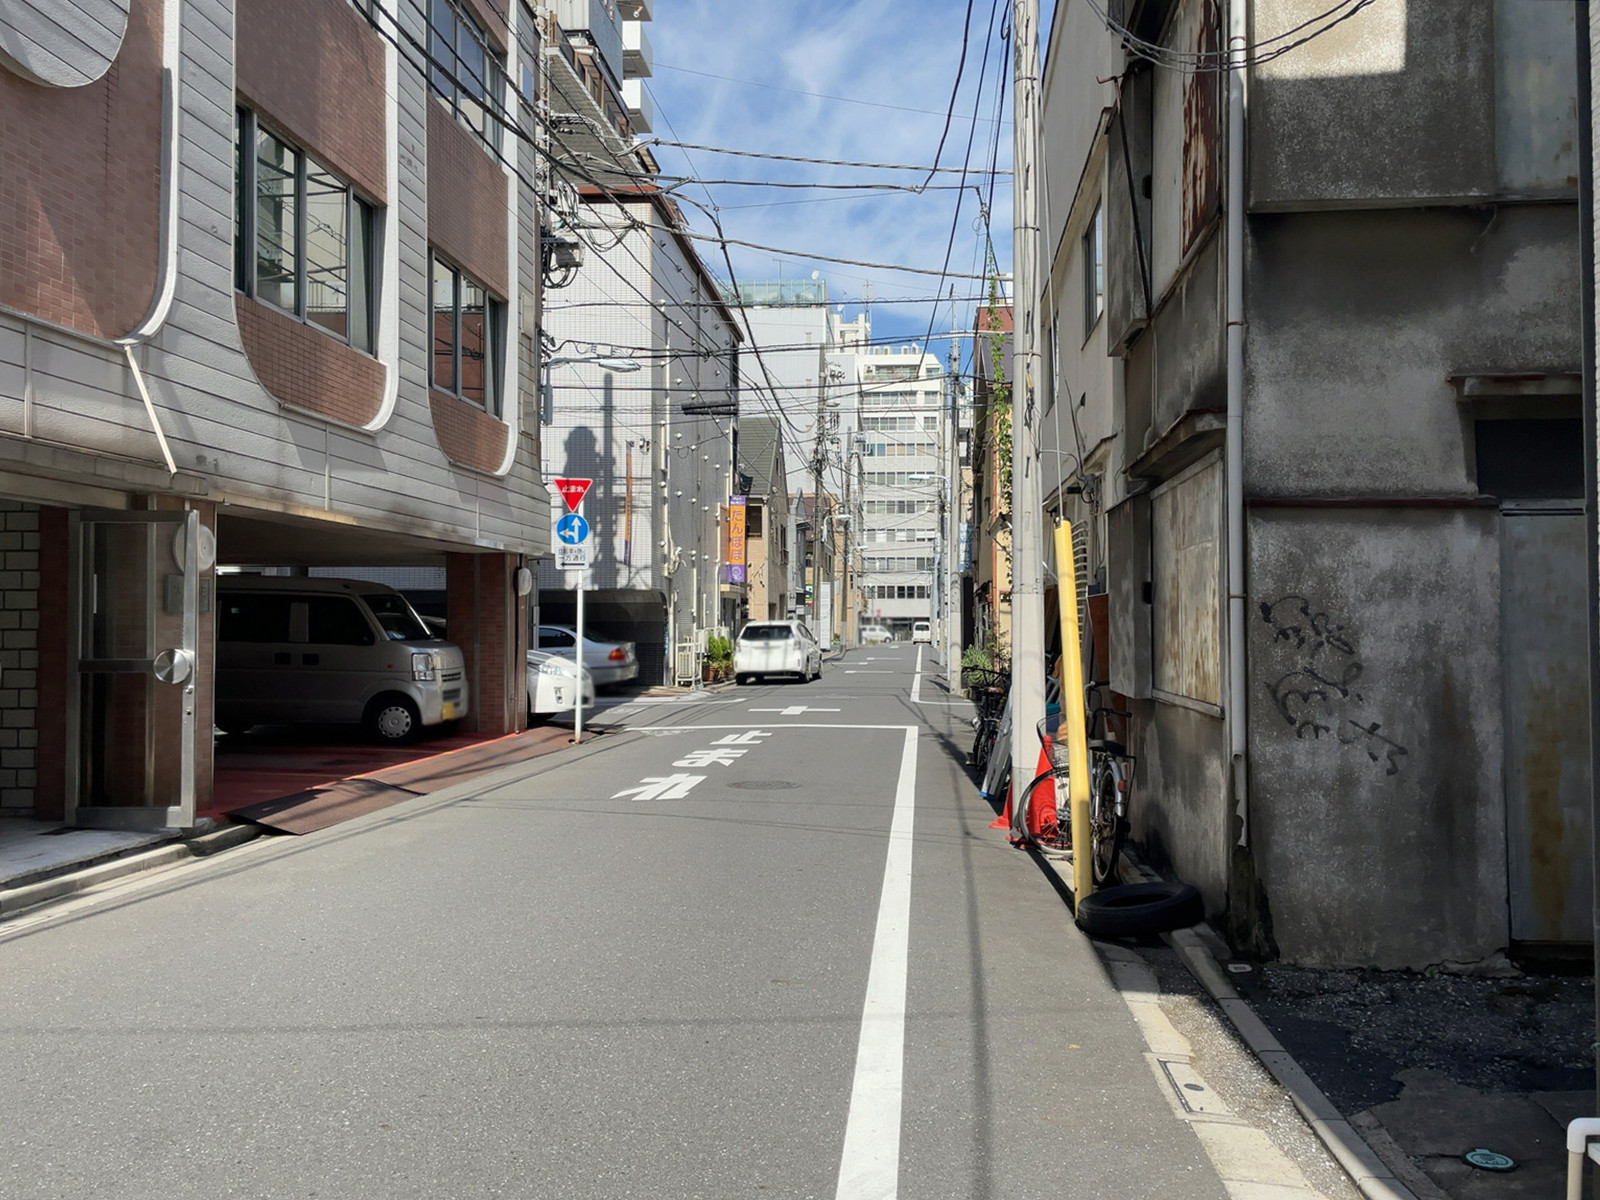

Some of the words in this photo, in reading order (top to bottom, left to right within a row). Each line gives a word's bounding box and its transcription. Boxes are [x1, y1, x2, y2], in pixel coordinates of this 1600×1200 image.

[562, 485, 585, 493] 止まれ
[609, 729, 773, 801] 止まれ
